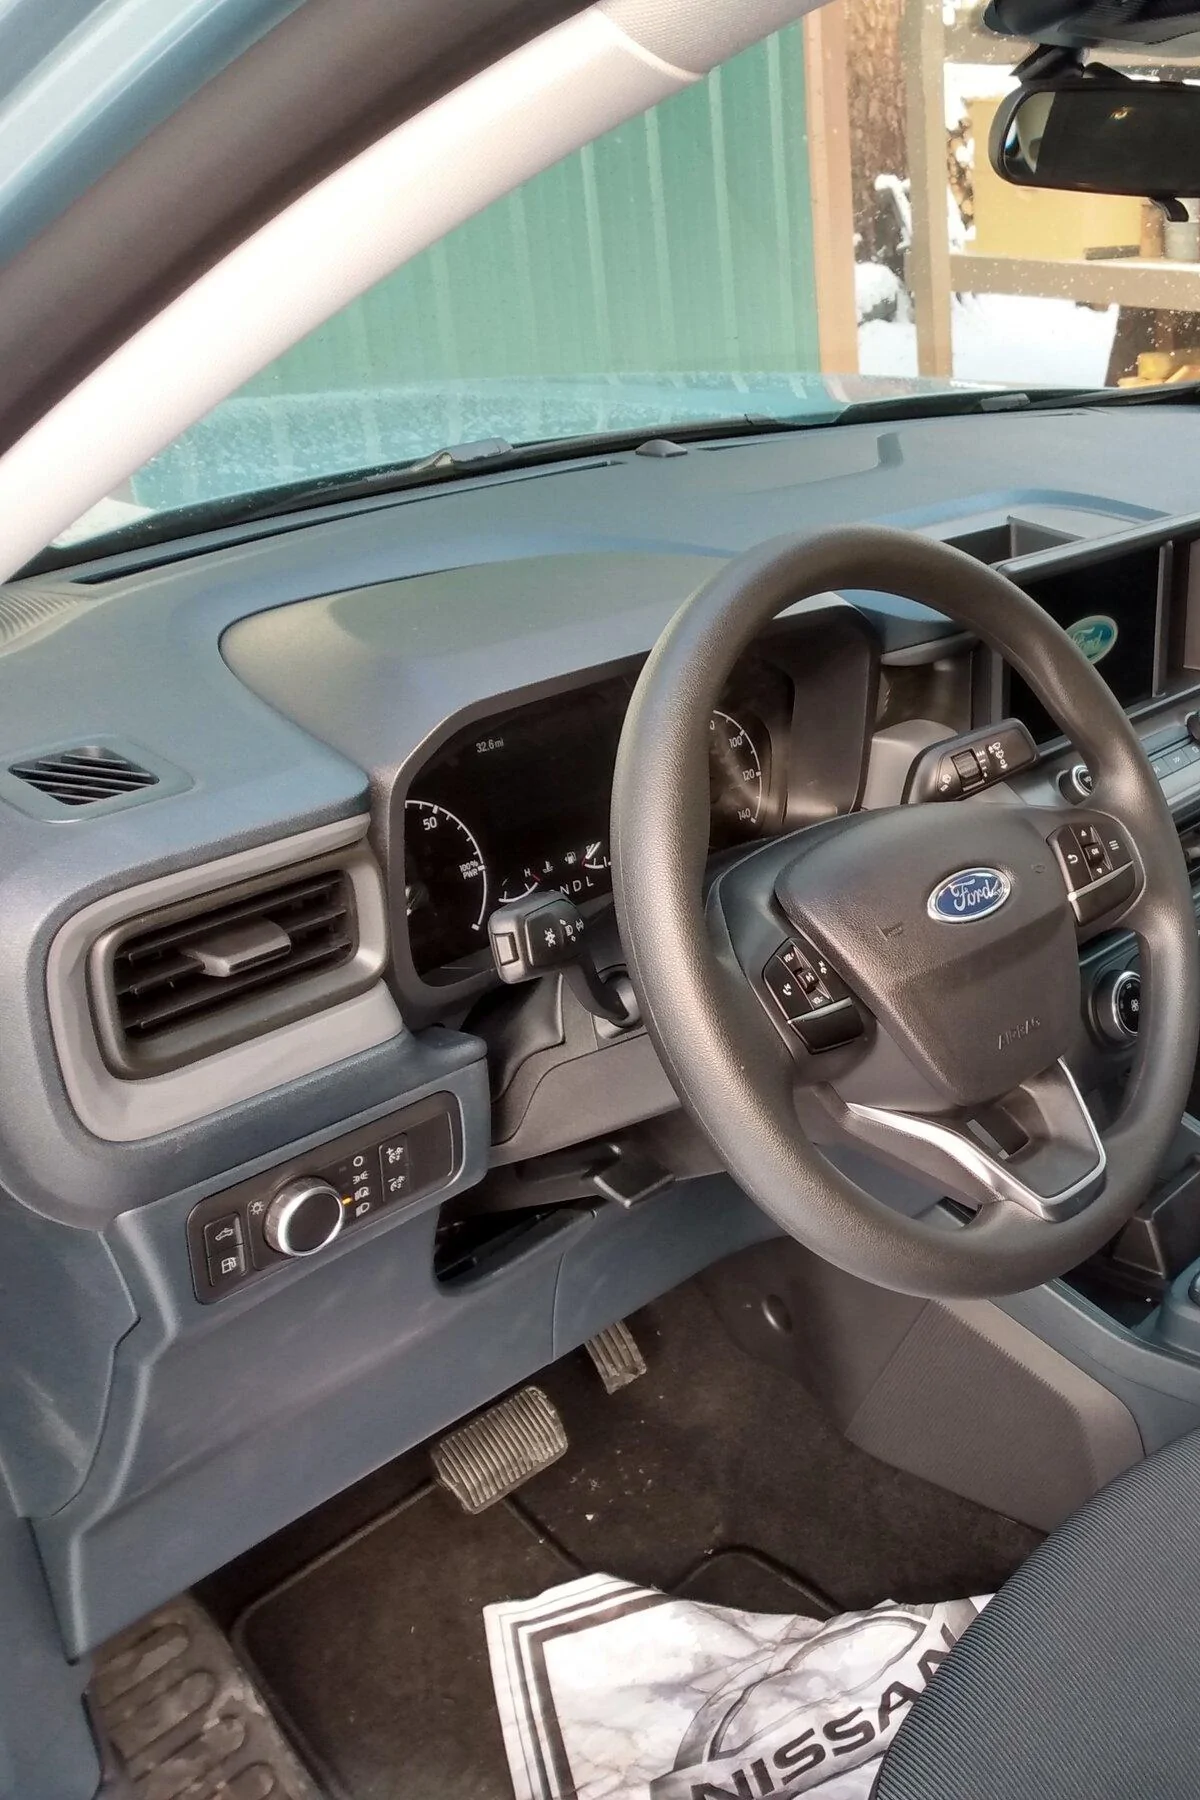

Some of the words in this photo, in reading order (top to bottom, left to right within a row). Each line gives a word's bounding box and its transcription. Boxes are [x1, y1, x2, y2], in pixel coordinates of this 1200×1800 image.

[729, 735, 743, 749] 100
[742, 768, 755, 781] 120
[737, 807, 751, 820] 140
[422, 816, 438, 831] 50
[459, 860, 479, 872] 100%
[523, 867, 532, 878] H
[462, 868, 479, 880] PWR
[949, 878, 1004, 912] Ford
